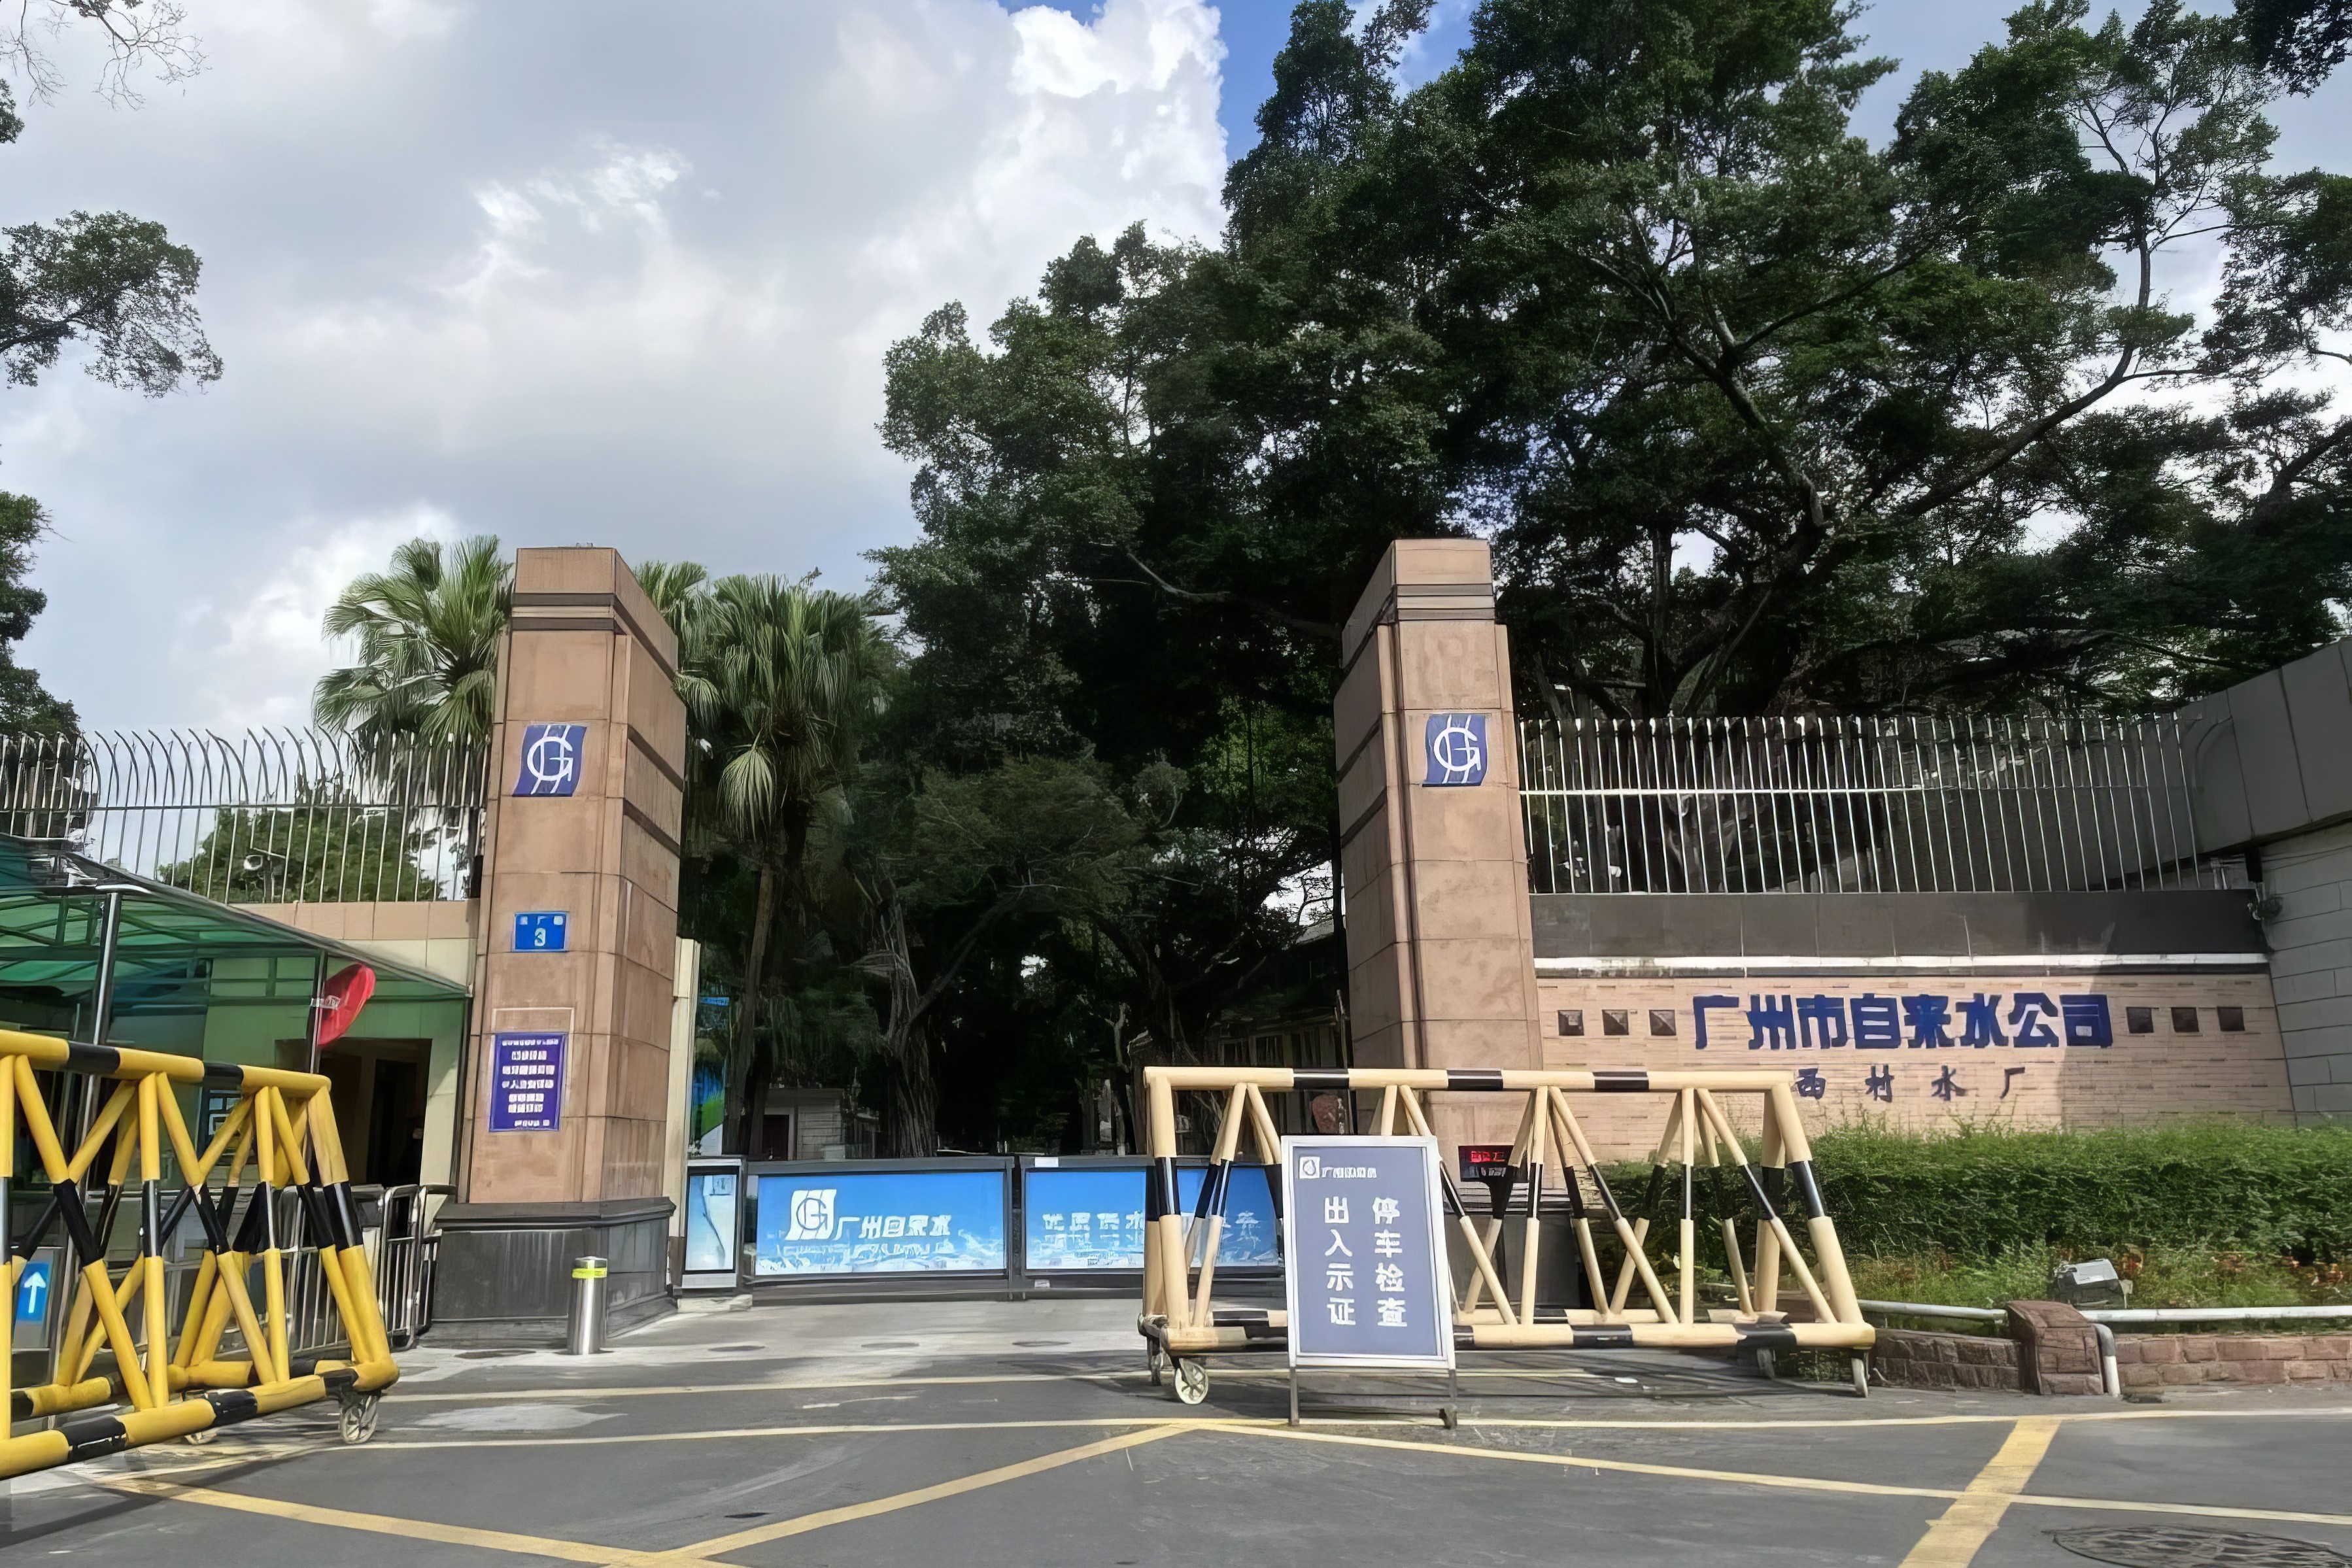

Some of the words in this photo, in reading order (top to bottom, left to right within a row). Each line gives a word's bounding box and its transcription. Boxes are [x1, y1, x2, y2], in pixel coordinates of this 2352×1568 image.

[534, 928, 546, 946] 3
[1693, 993, 2113, 1049] 广州市自来水公司
[1796, 1065, 2025, 1102] 西村水厂
[1325, 1196, 1355, 1325] 出入示证
[1372, 1197, 1407, 1327] 停车检查
